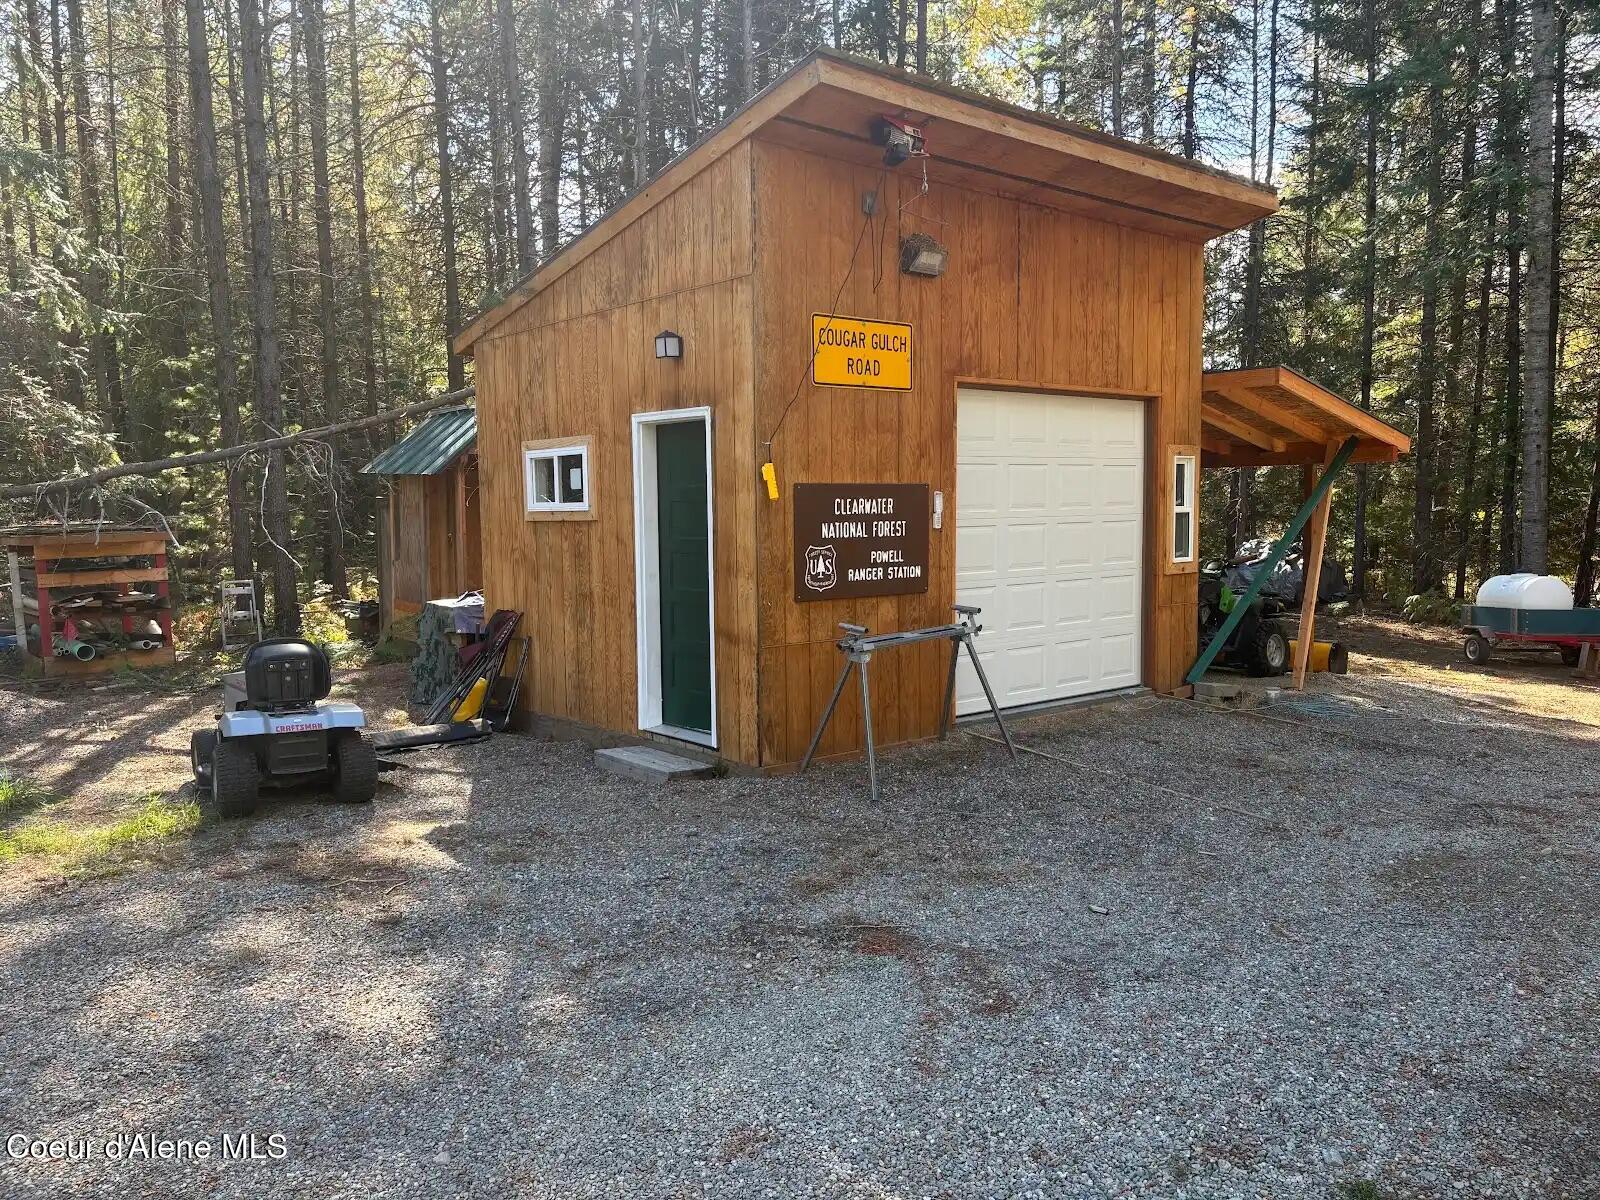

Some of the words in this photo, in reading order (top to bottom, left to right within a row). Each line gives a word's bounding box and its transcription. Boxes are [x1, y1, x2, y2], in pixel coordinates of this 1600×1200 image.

[819, 328, 866, 348] COUGAR
[871, 333, 907, 352] GULCH
[847, 357, 880, 376] ROAD
[834, 498, 894, 515] CLEARWATER
[821, 521, 868, 539] NATIONAL
[872, 520, 906, 537] FOREST
[870, 550, 904, 563] POWELL
[848, 567, 883, 582] RANGER
[887, 566, 921, 579] STATION
[275, 723, 323, 732] CRAFTSMAN
